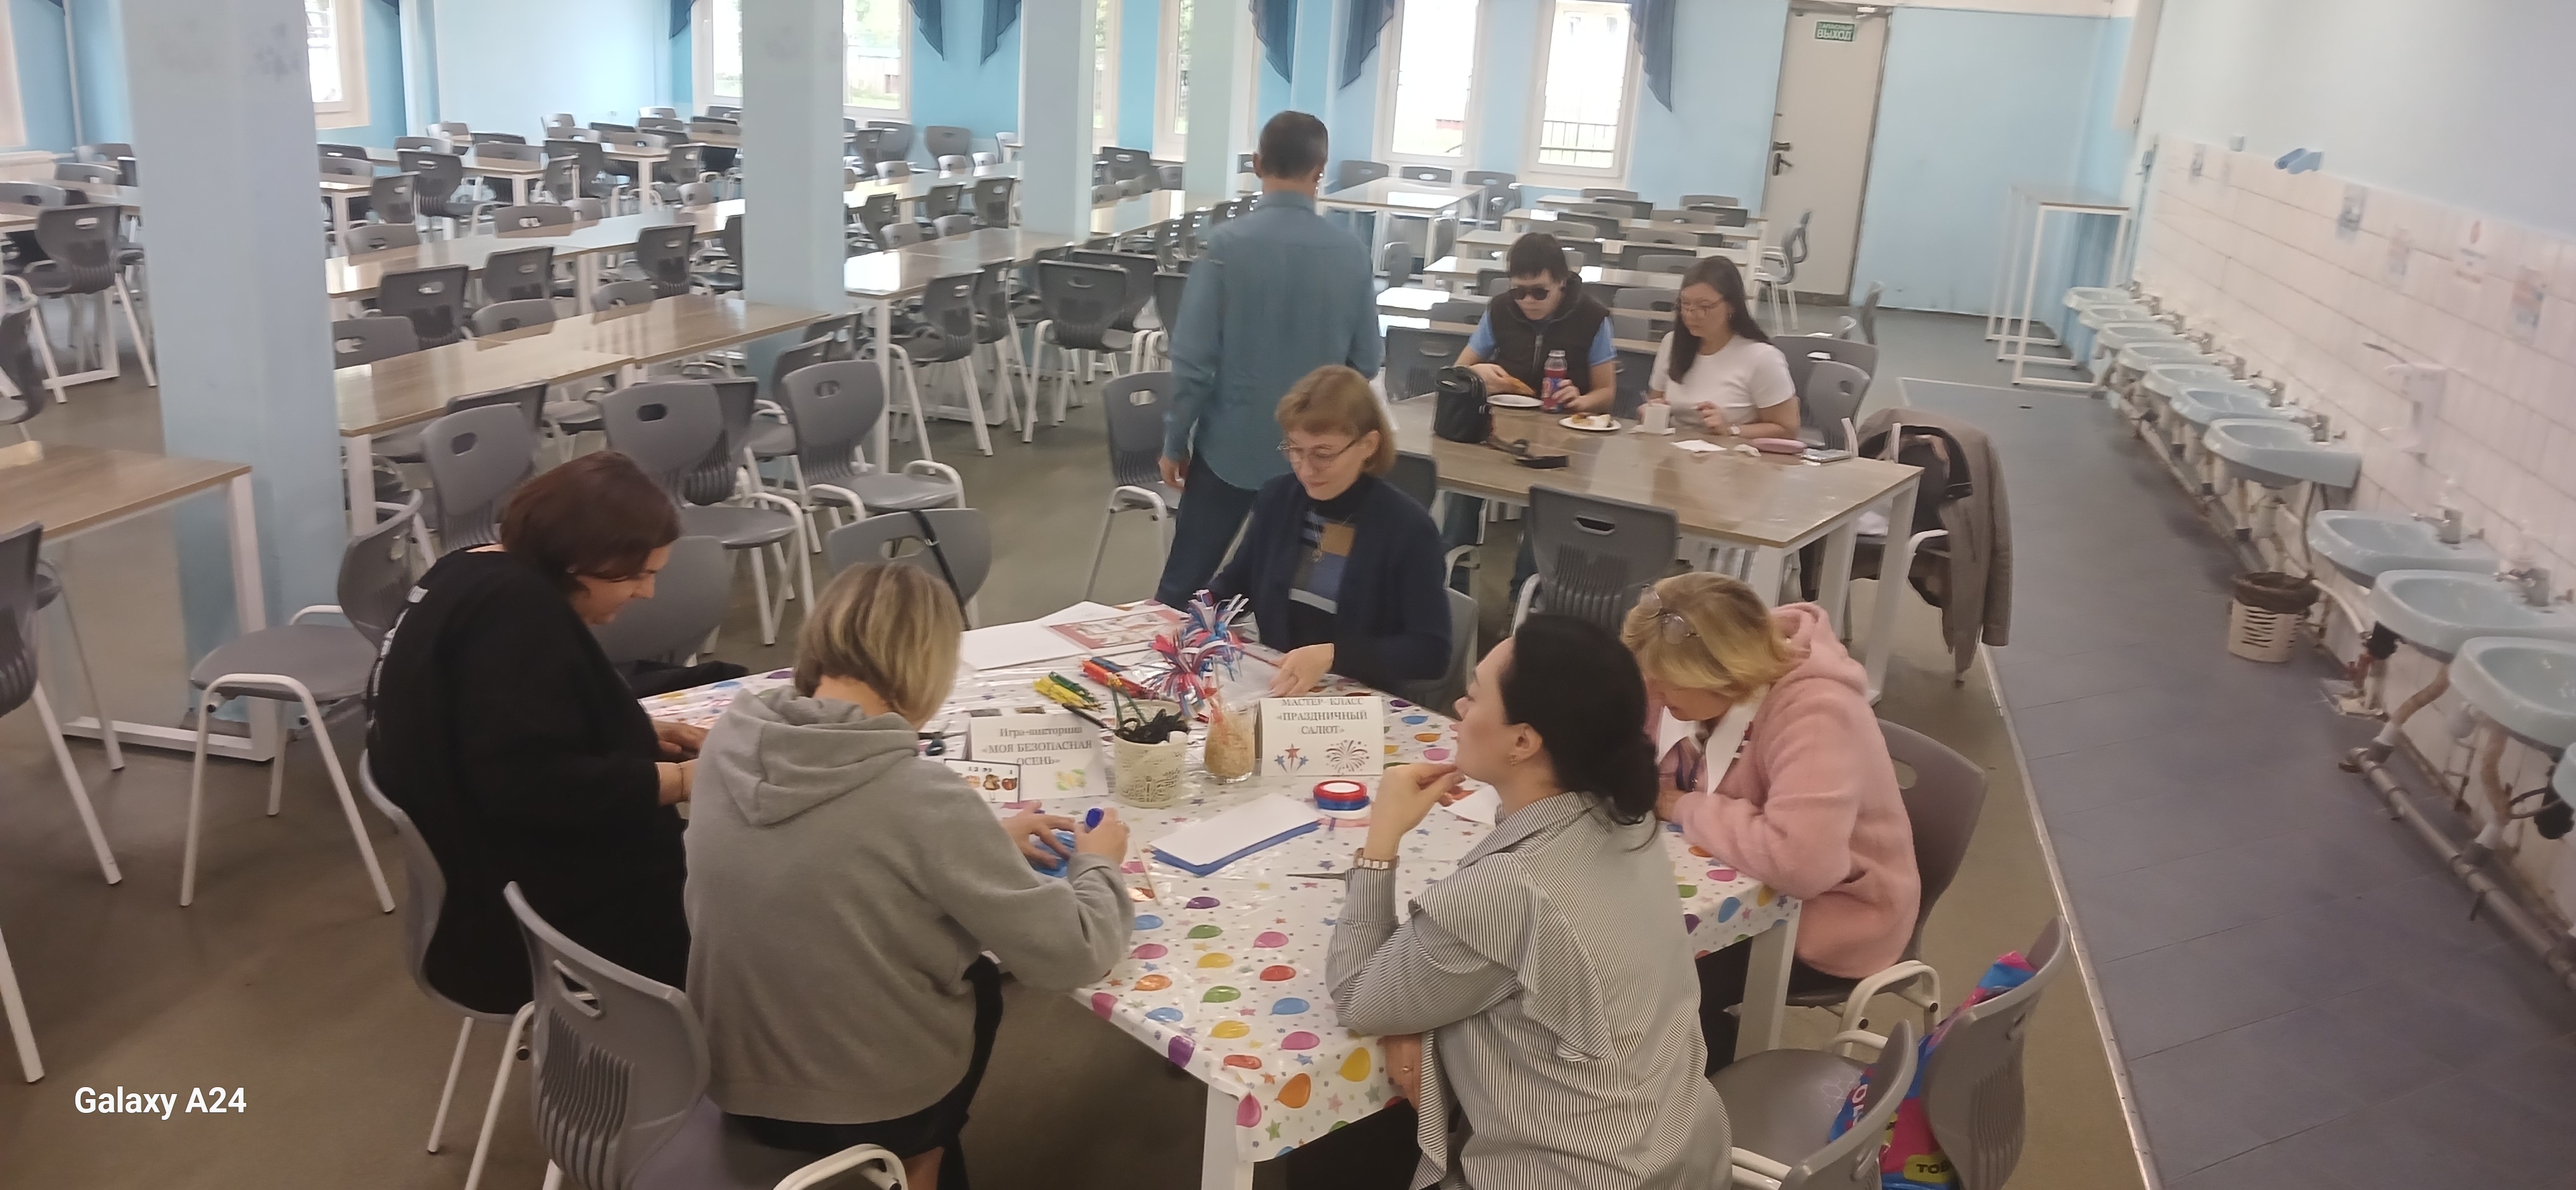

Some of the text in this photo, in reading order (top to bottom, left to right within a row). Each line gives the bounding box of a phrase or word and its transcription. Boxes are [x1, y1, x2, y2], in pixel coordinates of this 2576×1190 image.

[1817, 29, 1852, 40] ВЫХОД
[1277, 710, 1368, 721] «ПРАЗДНИЧНЫЙ
[1301, 726, 1345, 734] САЛЮТ»
[1017, 740, 1092, 752] БЕЗОПАСНАЯ
